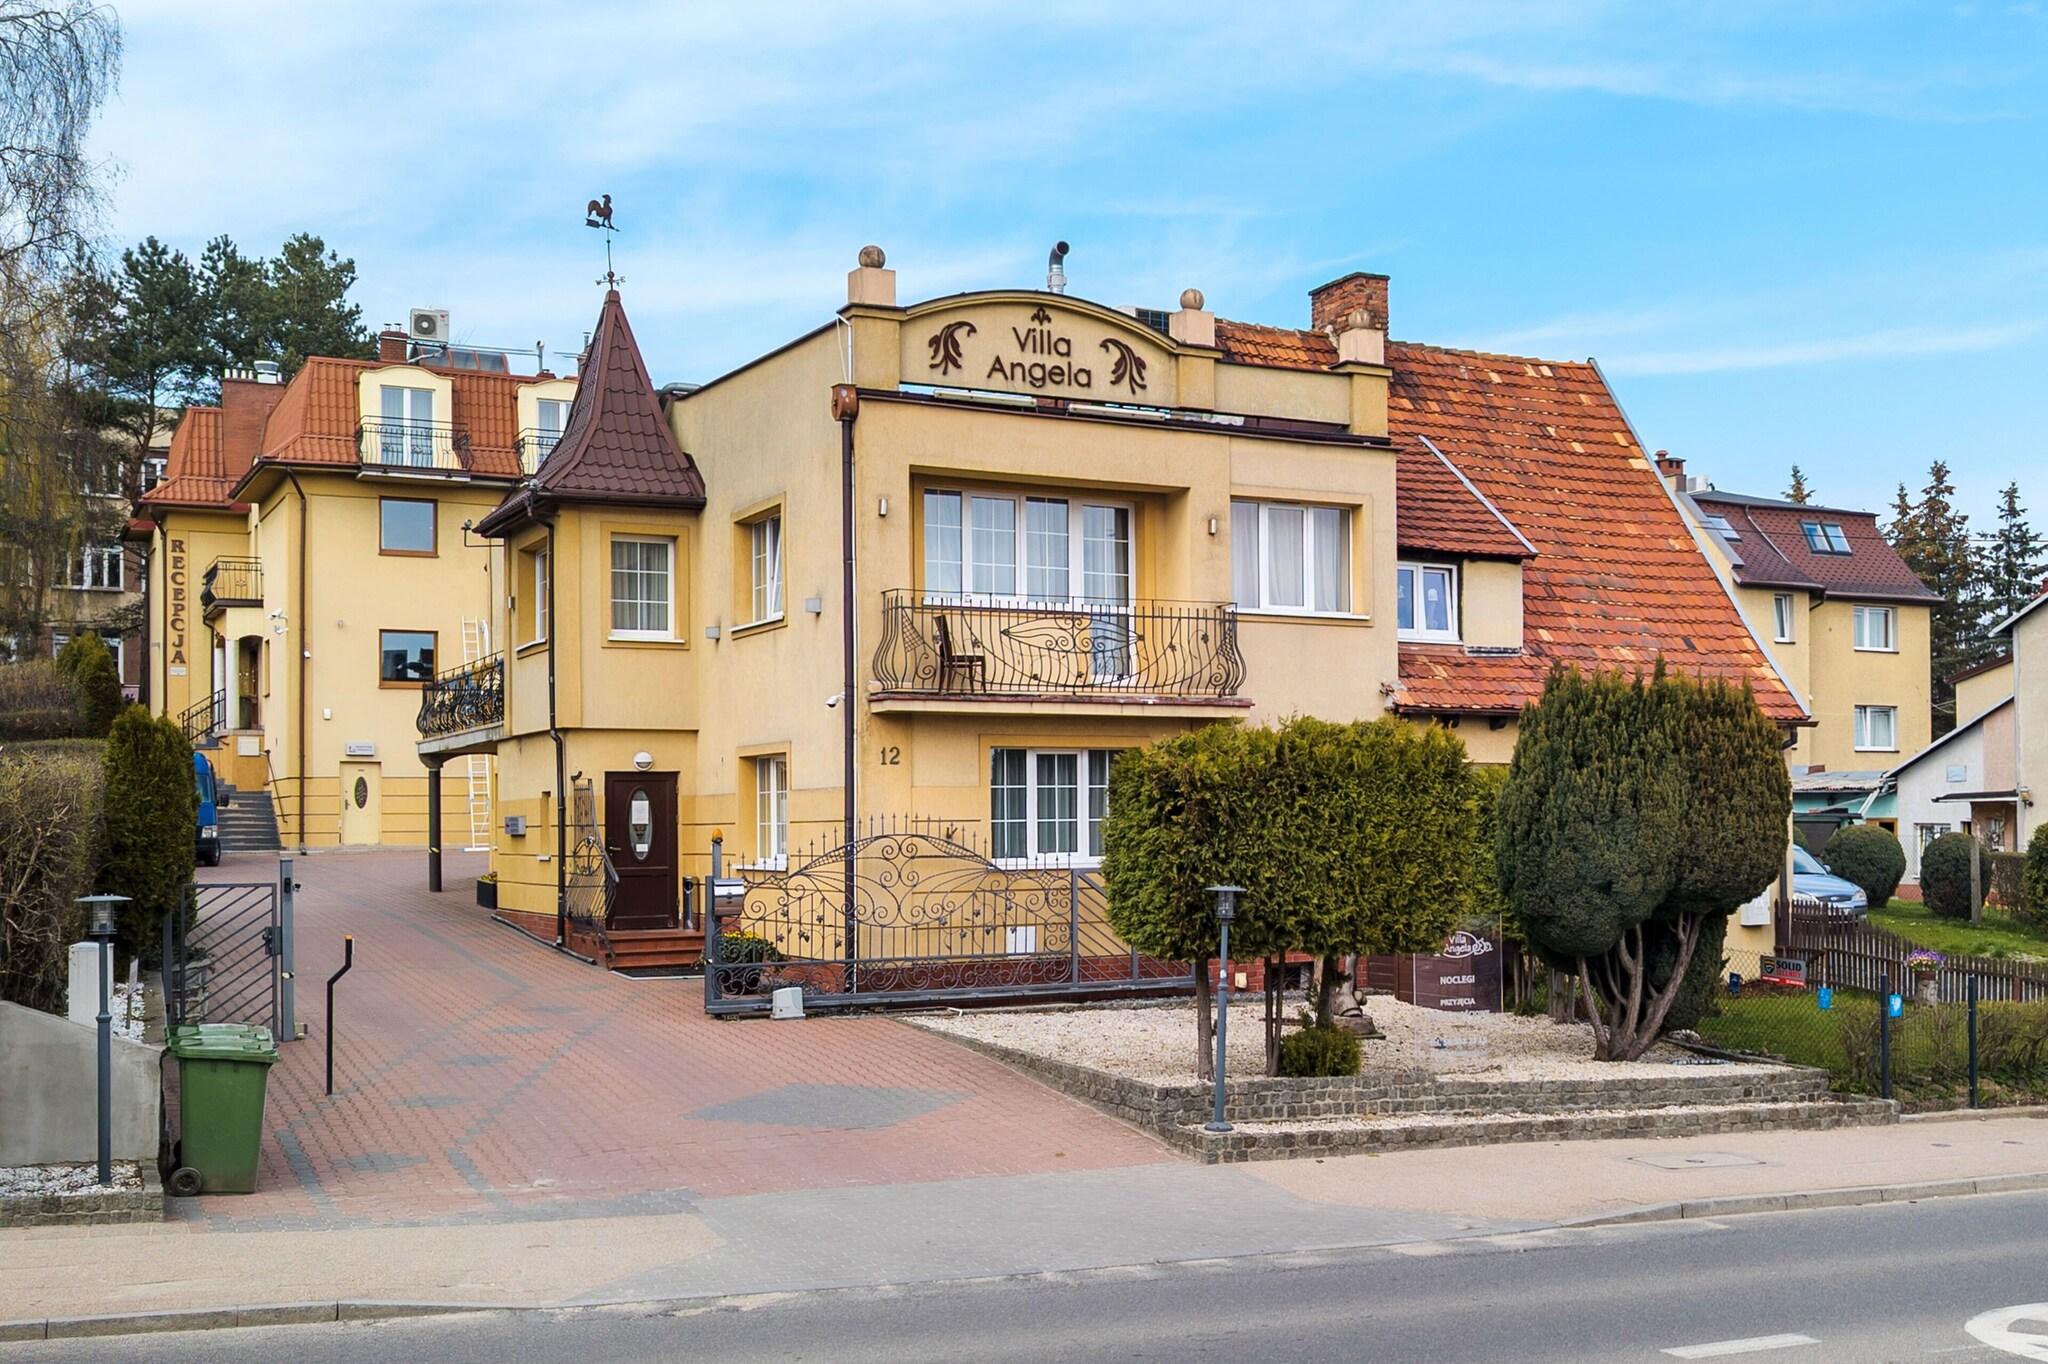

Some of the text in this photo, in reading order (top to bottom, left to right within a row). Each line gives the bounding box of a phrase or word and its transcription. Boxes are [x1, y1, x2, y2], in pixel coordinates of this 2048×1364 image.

[1012, 326, 1071, 357] Villa
[986, 354, 1091, 388] Angela
[170, 539, 186, 664] RECEPCJA
[880, 746, 900, 766] 12
[1448, 934, 1467, 944] Villa
[1443, 943, 1471, 955] Angela
[1776, 960, 1802, 971] SOLID
[1440, 975, 1476, 985] NOCLEGI
